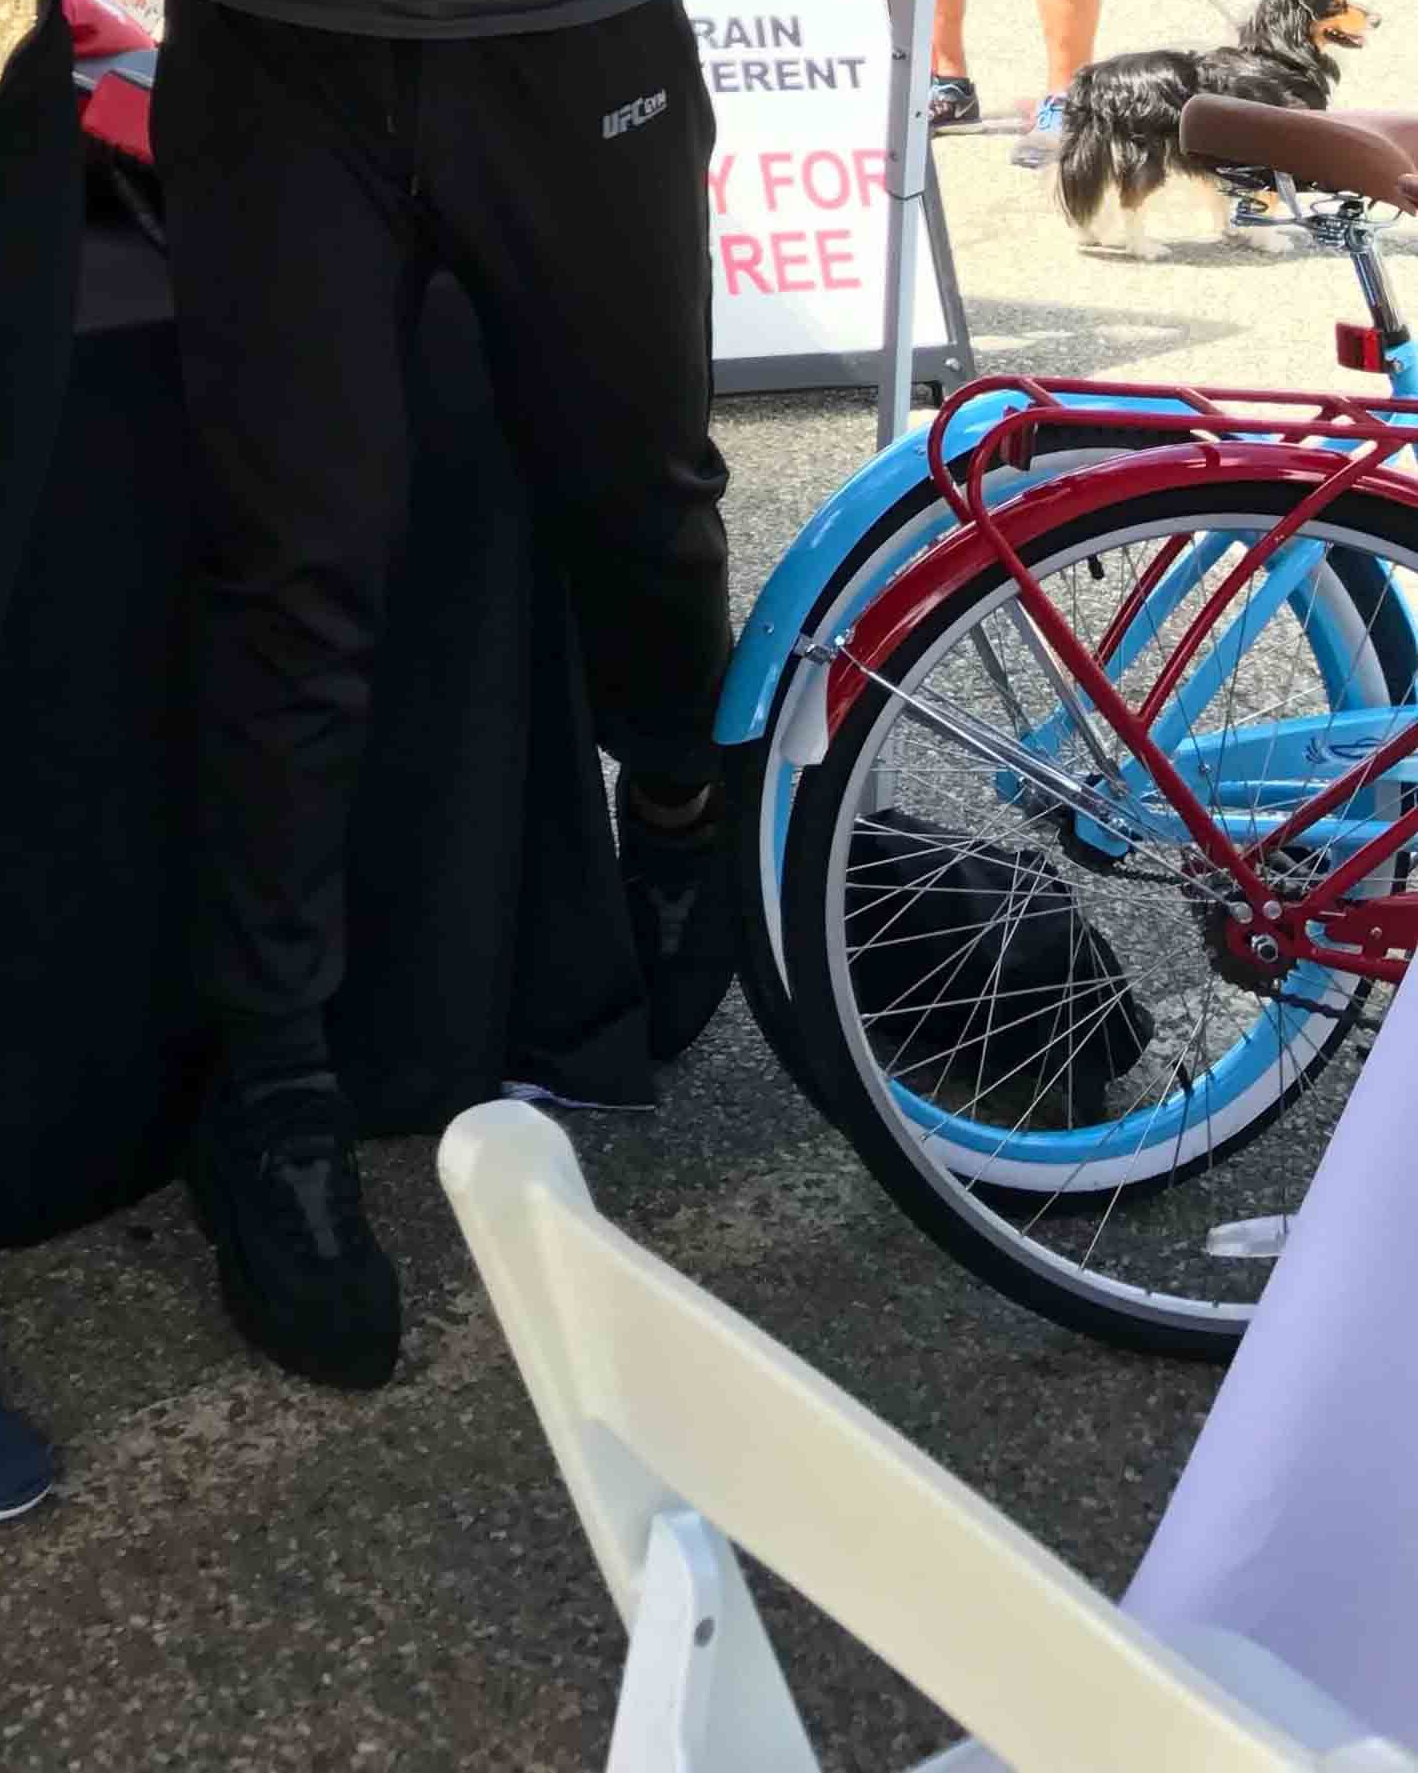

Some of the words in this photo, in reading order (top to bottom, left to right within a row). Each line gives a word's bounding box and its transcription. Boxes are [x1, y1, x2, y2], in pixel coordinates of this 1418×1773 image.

[685, 14, 803, 50] RAIN
[699, 56, 867, 94] ERENT
[602, 96, 645, 139] UFC
[717, 229, 863, 297] REE
